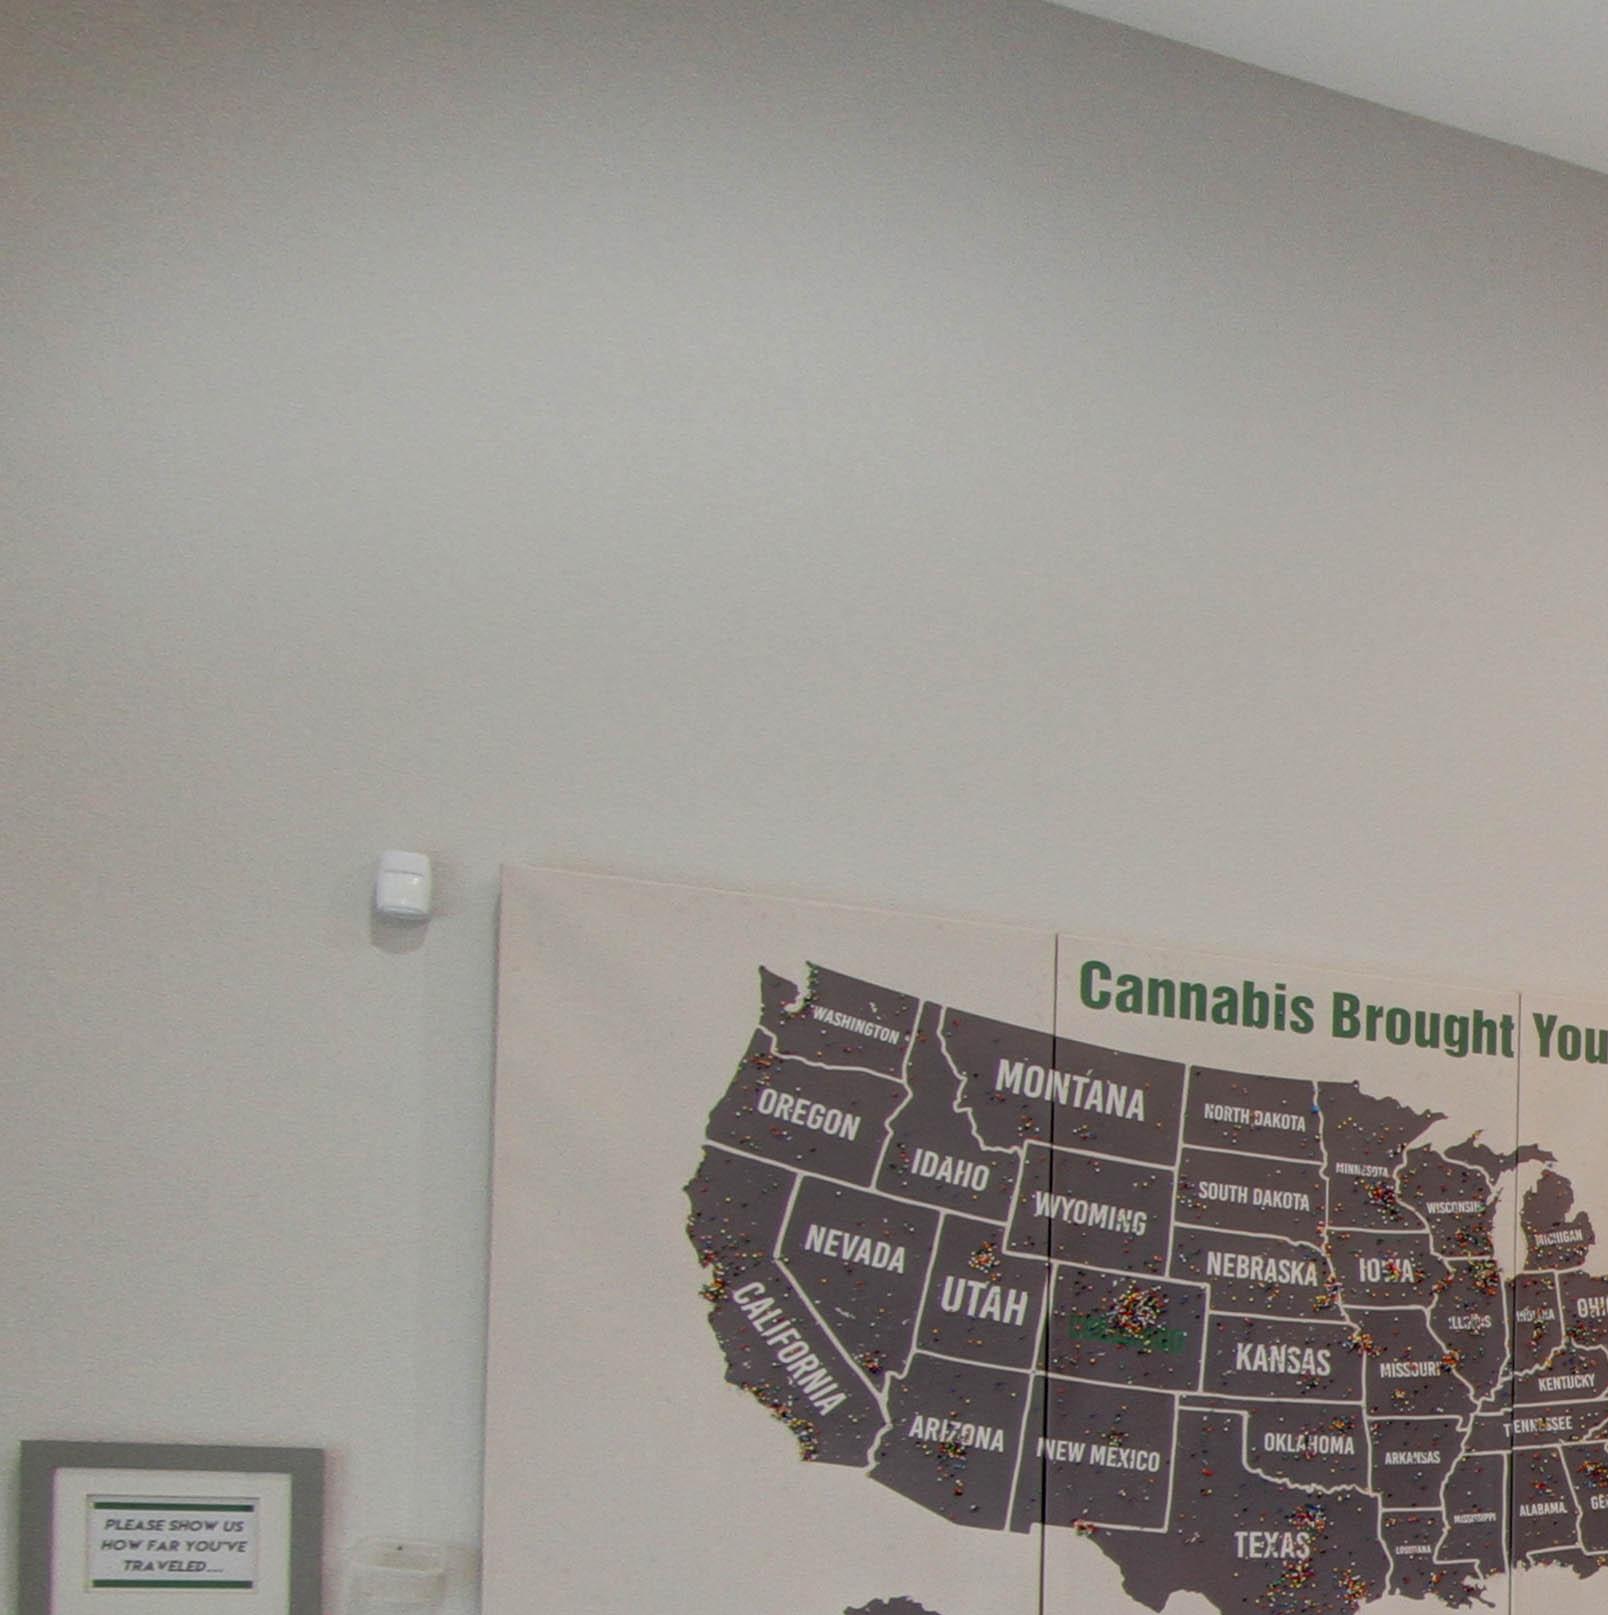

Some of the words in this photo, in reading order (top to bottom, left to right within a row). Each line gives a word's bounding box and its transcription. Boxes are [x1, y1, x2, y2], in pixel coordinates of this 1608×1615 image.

[813, 1005, 899, 1045] WASHINGTON
[1079, 960, 1315, 1035] Cannabis
[1331, 992, 1515, 1059] Brought
[995, 1059, 1145, 1122] MONTANA
[757, 1088, 860, 1141] OREGON
[1204, 1103, 1249, 1124] NORTH
[1254, 1111, 1306, 1132] DAKOTA
[911, 1148, 989, 1192] IDAHO
[1034, 1191, 1147, 1236] WYOMING
[1199, 1181, 1248, 1204] SOUTH
[1253, 1188, 1310, 1212] DAKOTA
[805, 1224, 905, 1274] NEVADA
[1206, 1251, 1318, 1287] NEBRASKA
[941, 1276, 1029, 1326] UTAH
[732, 1281, 847, 1417] CALIFORNIA
[1236, 1343, 1332, 1377] KANSAS
[1538, 1373, 1595, 1392] KENTUCKY
[908, 1415, 1004, 1452] ARIZONA
[1264, 1432, 1354, 1455] OKLAHOMA
[1037, 1437, 1088, 1463] NEW
[1090, 1444, 1160, 1472] MEXICO
[104, 1519, 164, 1532] PLEASE
[168, 1519, 217, 1532] SHOW
[223, 1520, 244, 1533] US
[101, 1539, 142, 1551] HOW
[146, 1539, 179, 1552] FAR
[185, 1540, 248, 1553] YOU'VE
[1234, 1530, 1311, 1559] TEXAS
